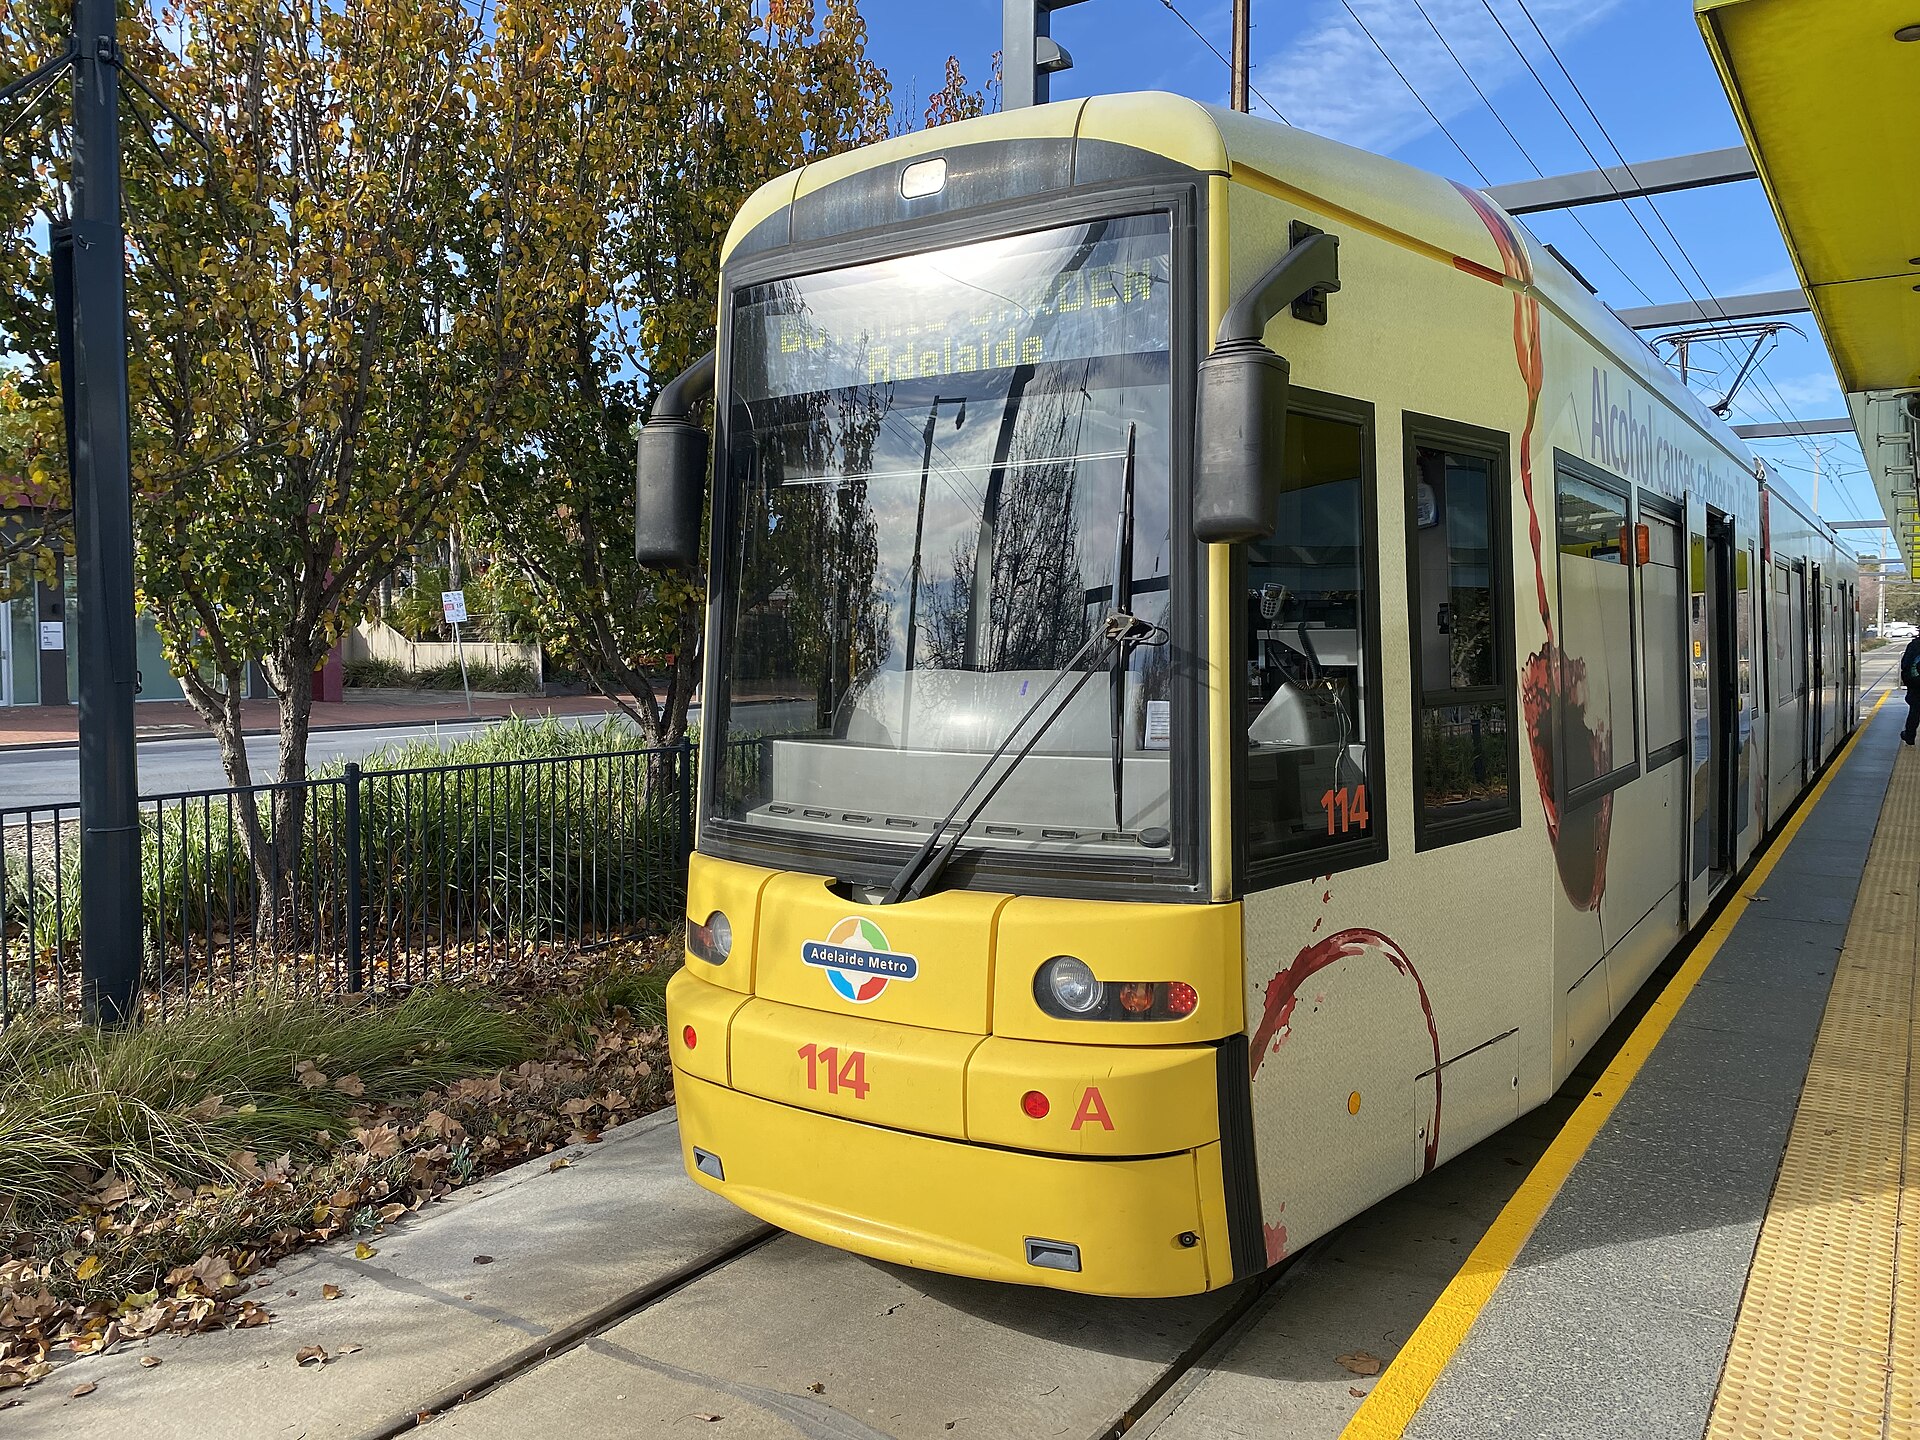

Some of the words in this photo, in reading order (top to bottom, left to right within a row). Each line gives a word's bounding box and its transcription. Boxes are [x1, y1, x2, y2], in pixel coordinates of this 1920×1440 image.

[969, 258, 1151, 326] RDEN
[868, 327, 1043, 385] Adelaide
[1591, 366, 1653, 488] Alcohol
[1657, 436, 1695, 502] causes
[1320, 784, 1369, 836] 114
[811, 947, 864, 967] Adelaide
[868, 956, 908, 973] Metro
[797, 1043, 870, 1100] 114
[1070, 1086, 1115, 1131] A
